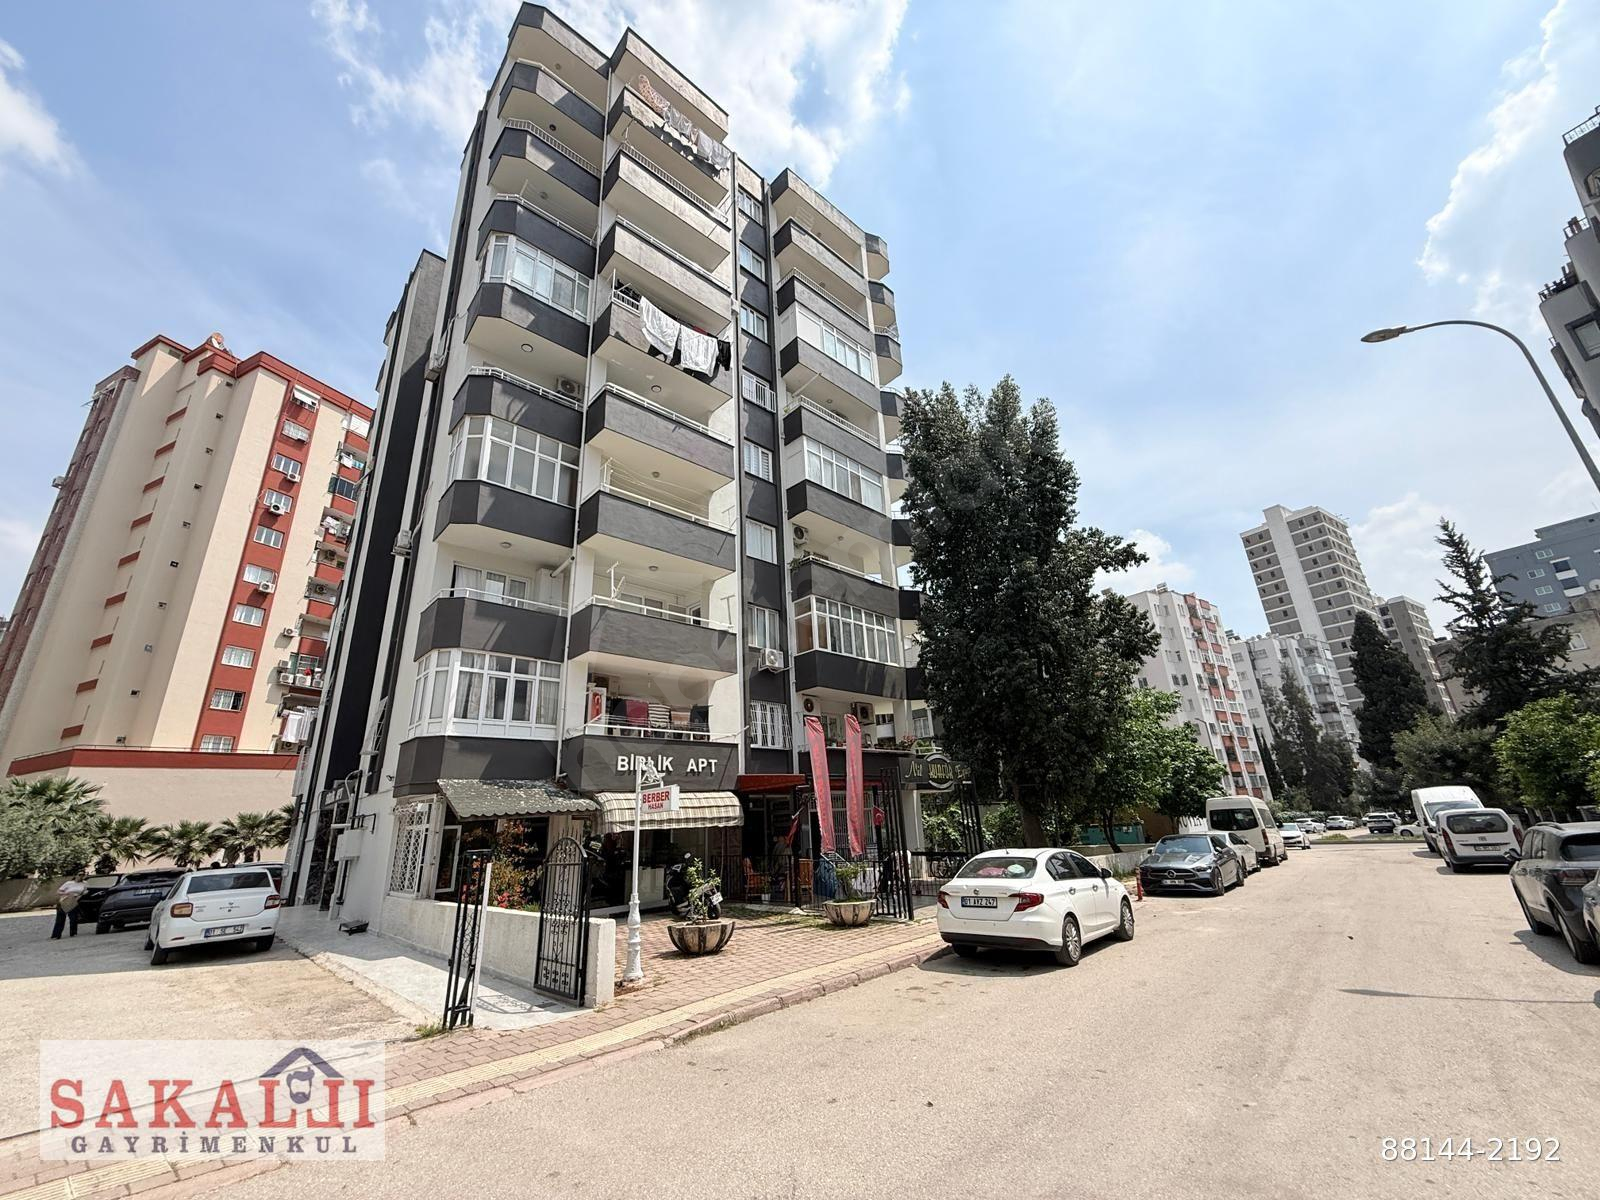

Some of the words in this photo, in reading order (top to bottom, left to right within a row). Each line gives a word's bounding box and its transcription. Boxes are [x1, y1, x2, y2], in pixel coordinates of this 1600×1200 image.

[687, 758, 718, 773] APT
[642, 790, 670, 804] BERBER
[648, 802, 664, 810] HASAN
